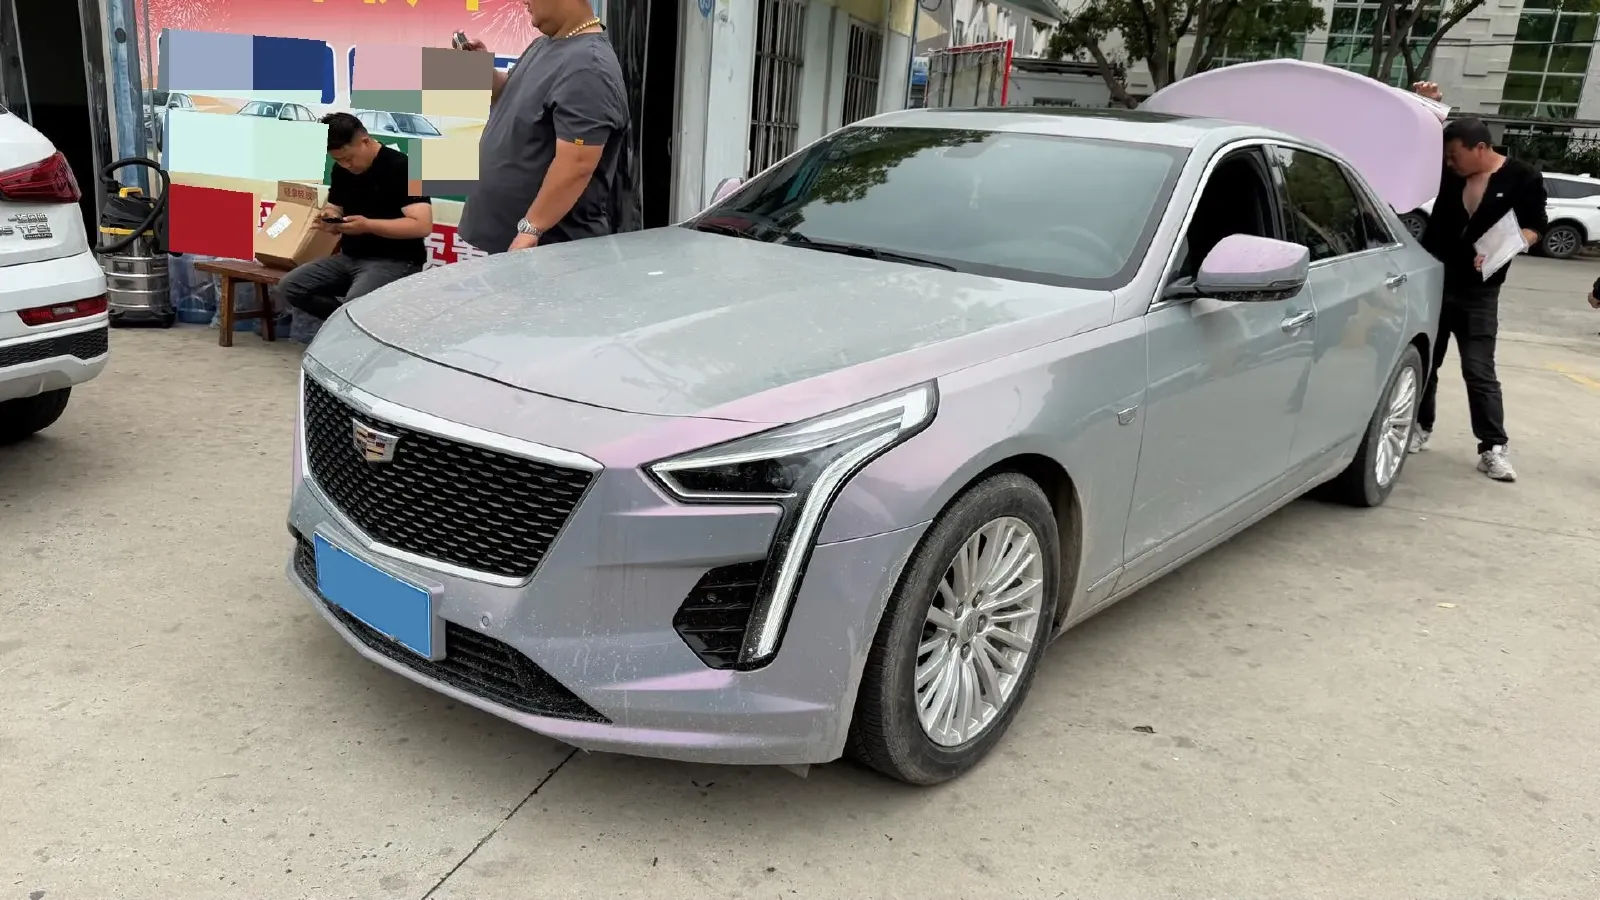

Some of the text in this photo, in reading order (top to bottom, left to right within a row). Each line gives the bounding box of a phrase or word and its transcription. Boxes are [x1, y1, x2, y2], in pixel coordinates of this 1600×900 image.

[284, 187, 313, 200] 轻拿轻放
[15, 223, 51, 234] TFSI
